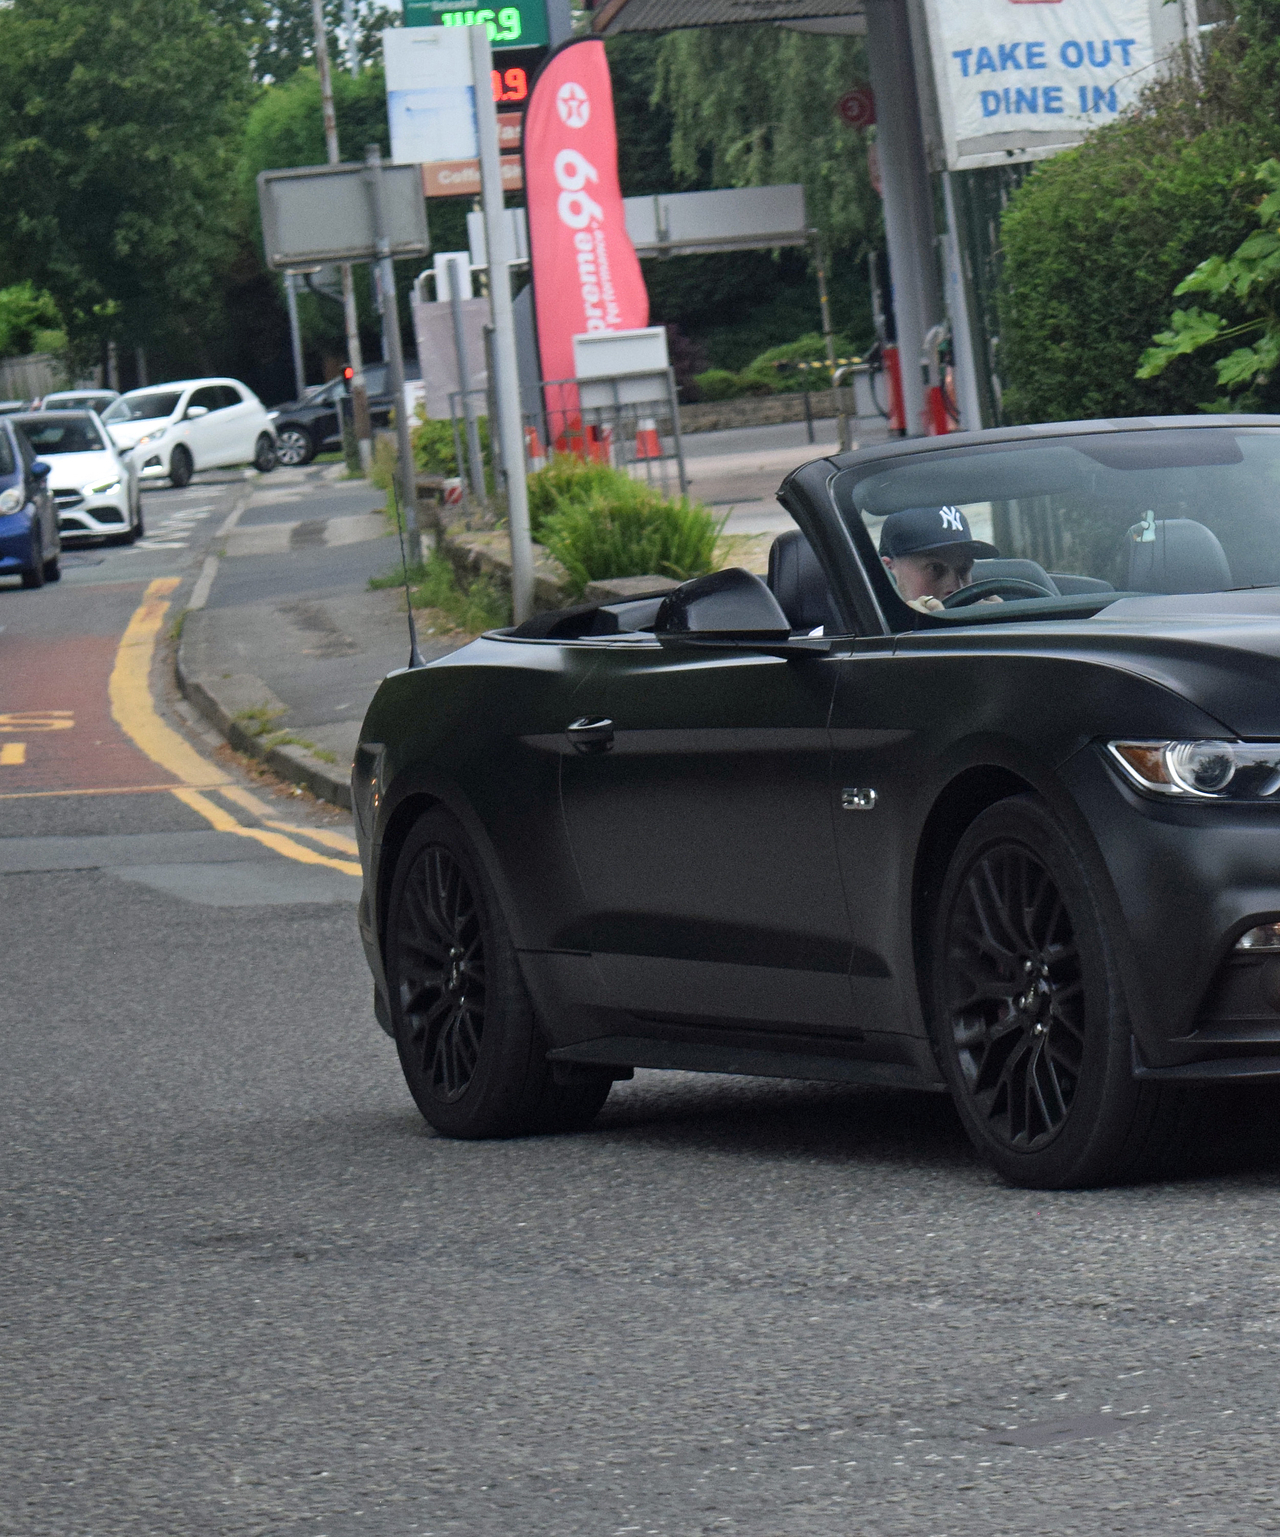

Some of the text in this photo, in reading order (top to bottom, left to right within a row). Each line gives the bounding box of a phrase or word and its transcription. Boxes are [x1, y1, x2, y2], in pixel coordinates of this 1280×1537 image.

[953, 39, 1136, 77] TAKE OUT
[980, 86, 1118, 117] DINE IN
[554, 149, 614, 334] preme 99
[939, 505, 963, 531] NY
